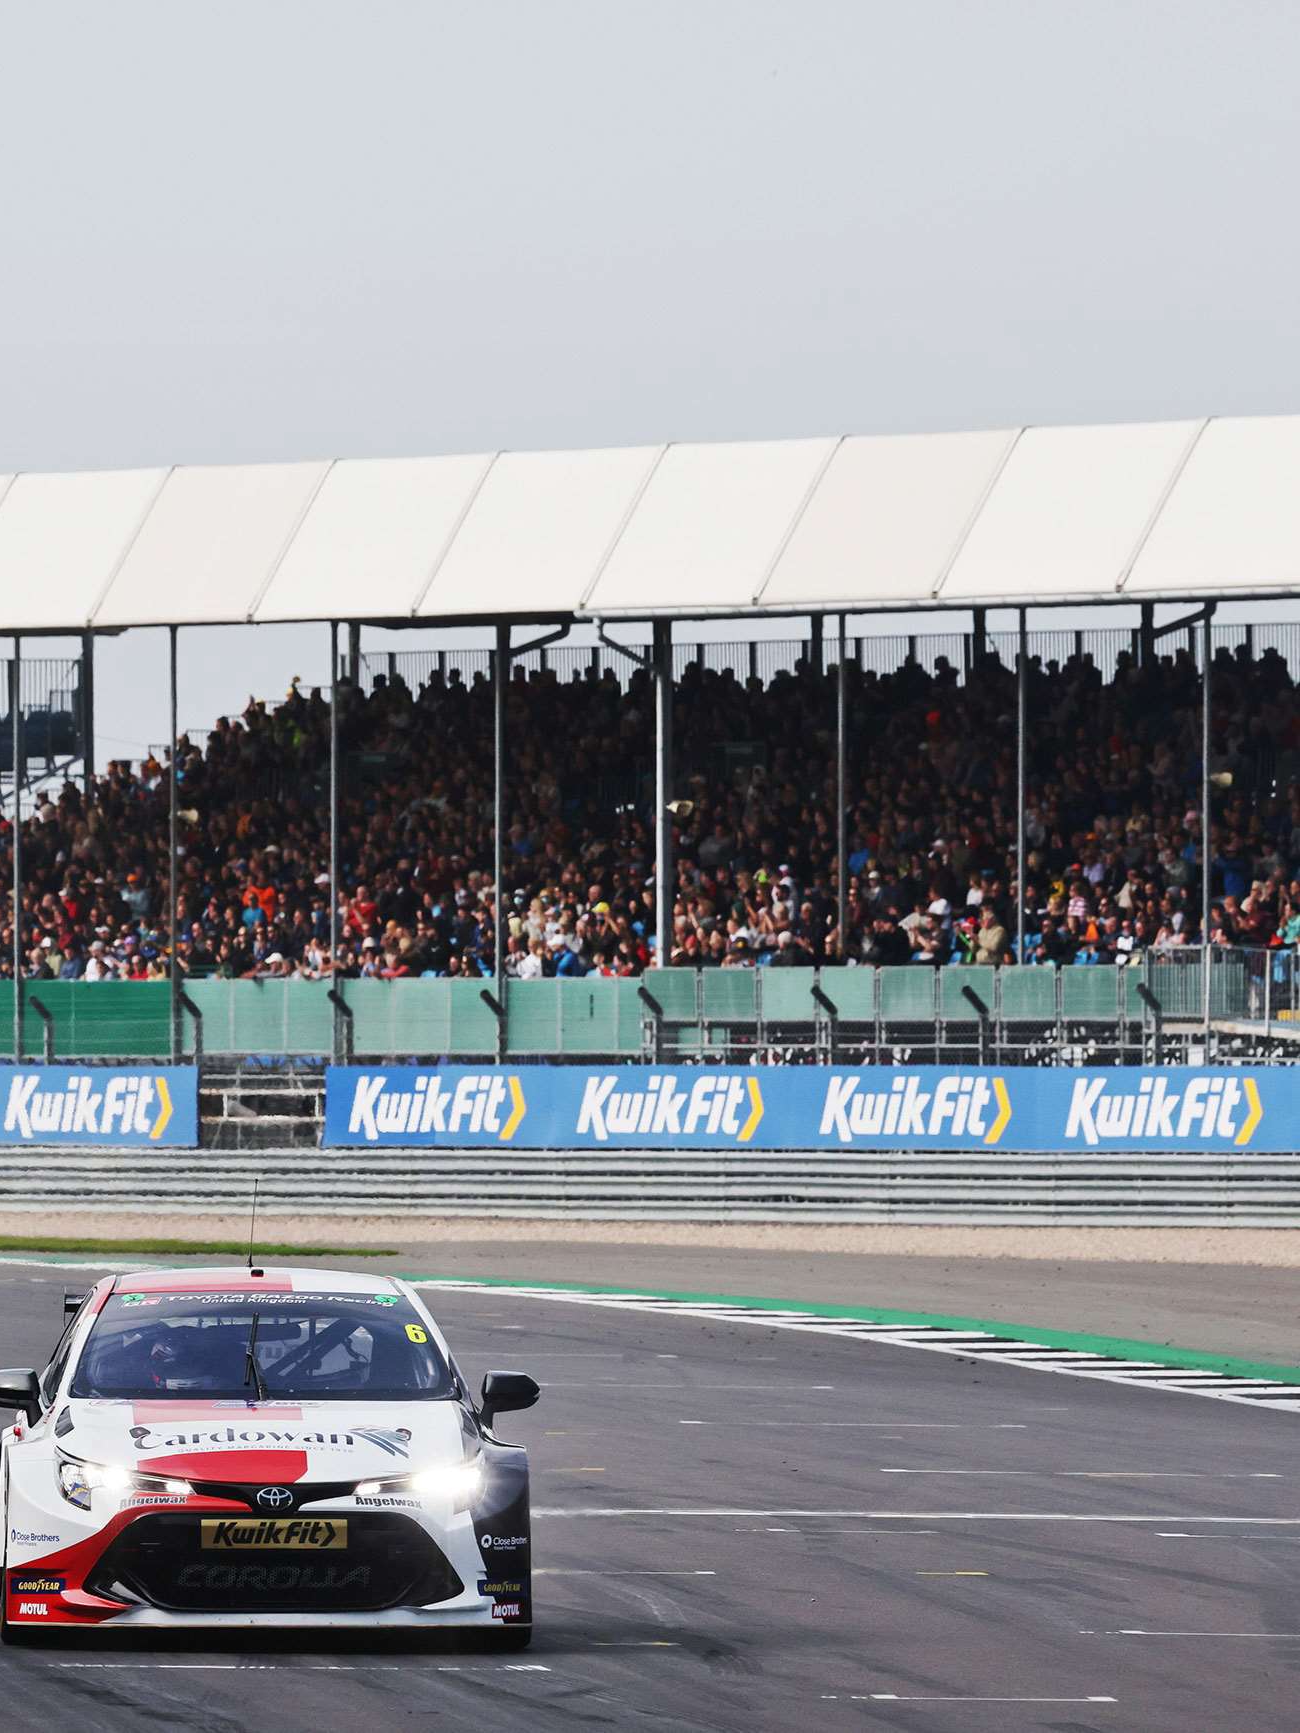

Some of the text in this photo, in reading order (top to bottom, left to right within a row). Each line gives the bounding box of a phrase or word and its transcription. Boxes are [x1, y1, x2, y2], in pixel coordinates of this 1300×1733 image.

[404, 1323, 428, 1344] 6
[129, 1426, 354, 1450] Cardowan
[119, 1494, 188, 1510] Angelwax
[354, 1495, 423, 1509] Angelwax
[30, 1532, 60, 1543] Brothers
[177, 1564, 372, 1590] COROLLA
[19, 1602, 48, 1615] MOTUL
[493, 1604, 520, 1617] MOTUL
